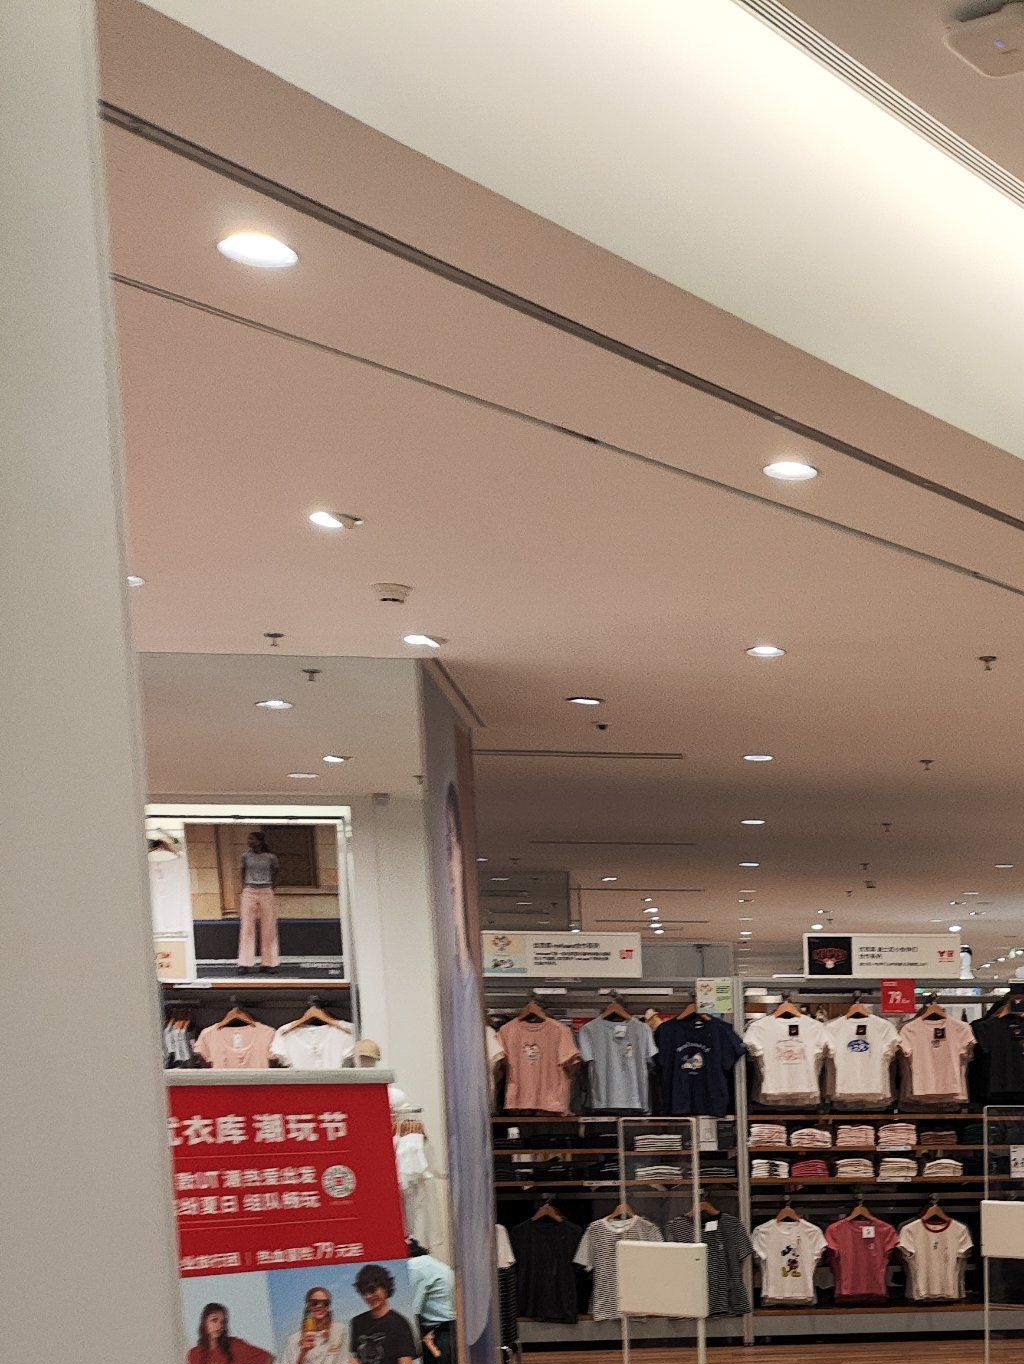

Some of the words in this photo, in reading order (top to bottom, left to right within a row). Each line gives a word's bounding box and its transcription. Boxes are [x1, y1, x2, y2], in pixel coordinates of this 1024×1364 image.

[252, 1111, 349, 1143] 潮玩节
[174, 1195, 239, 1216] 纷夏日
